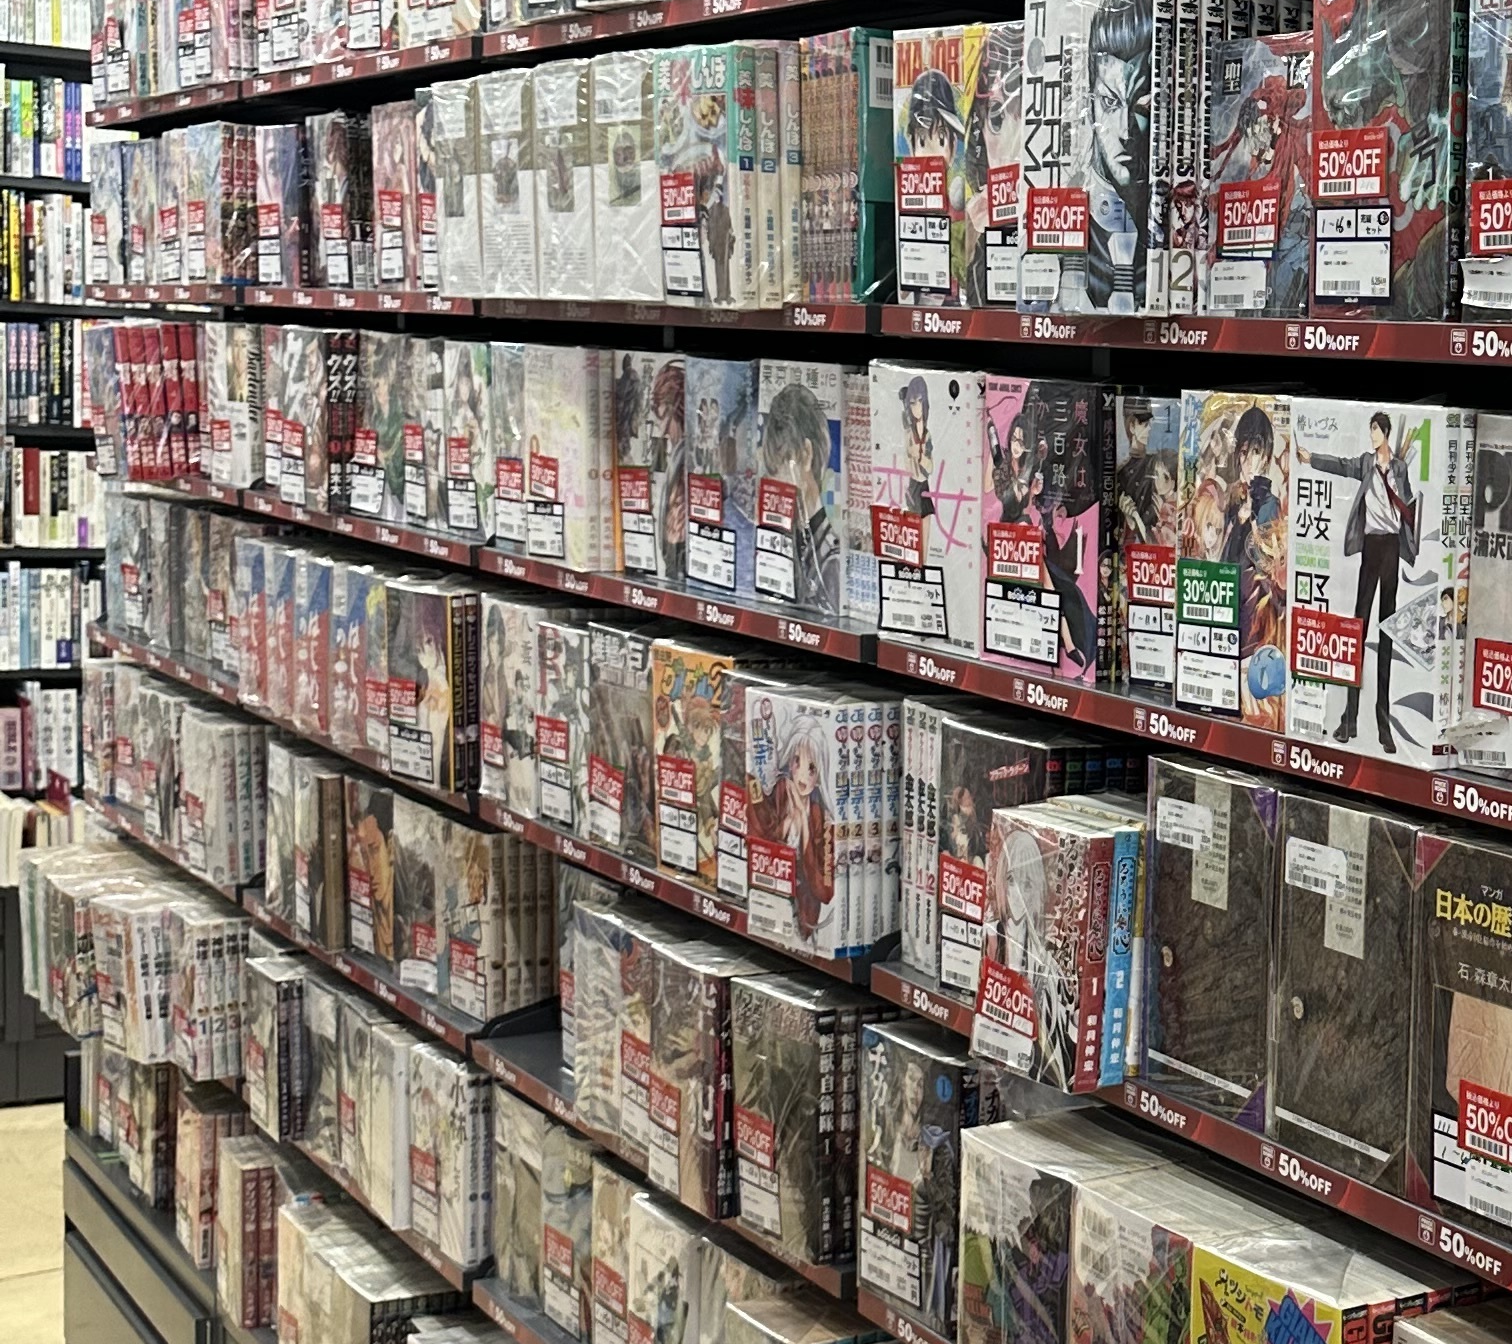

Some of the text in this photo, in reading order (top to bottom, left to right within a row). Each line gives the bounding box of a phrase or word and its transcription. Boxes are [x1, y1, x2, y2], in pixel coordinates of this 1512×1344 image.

[895, 37, 963, 89] MAJOR
[1318, 149, 1381, 177] 50%OFF
[1303, 327, 1360, 352] 50%OFF
[1296, 477, 1333, 508] 月刊
[1295, 509, 1331, 542] 少女
[1182, 581, 1235, 605] 30%OFF
[1296, 628, 1357, 660] 50%OFF
[1438, 1226, 1502, 1278] 50%OFF
